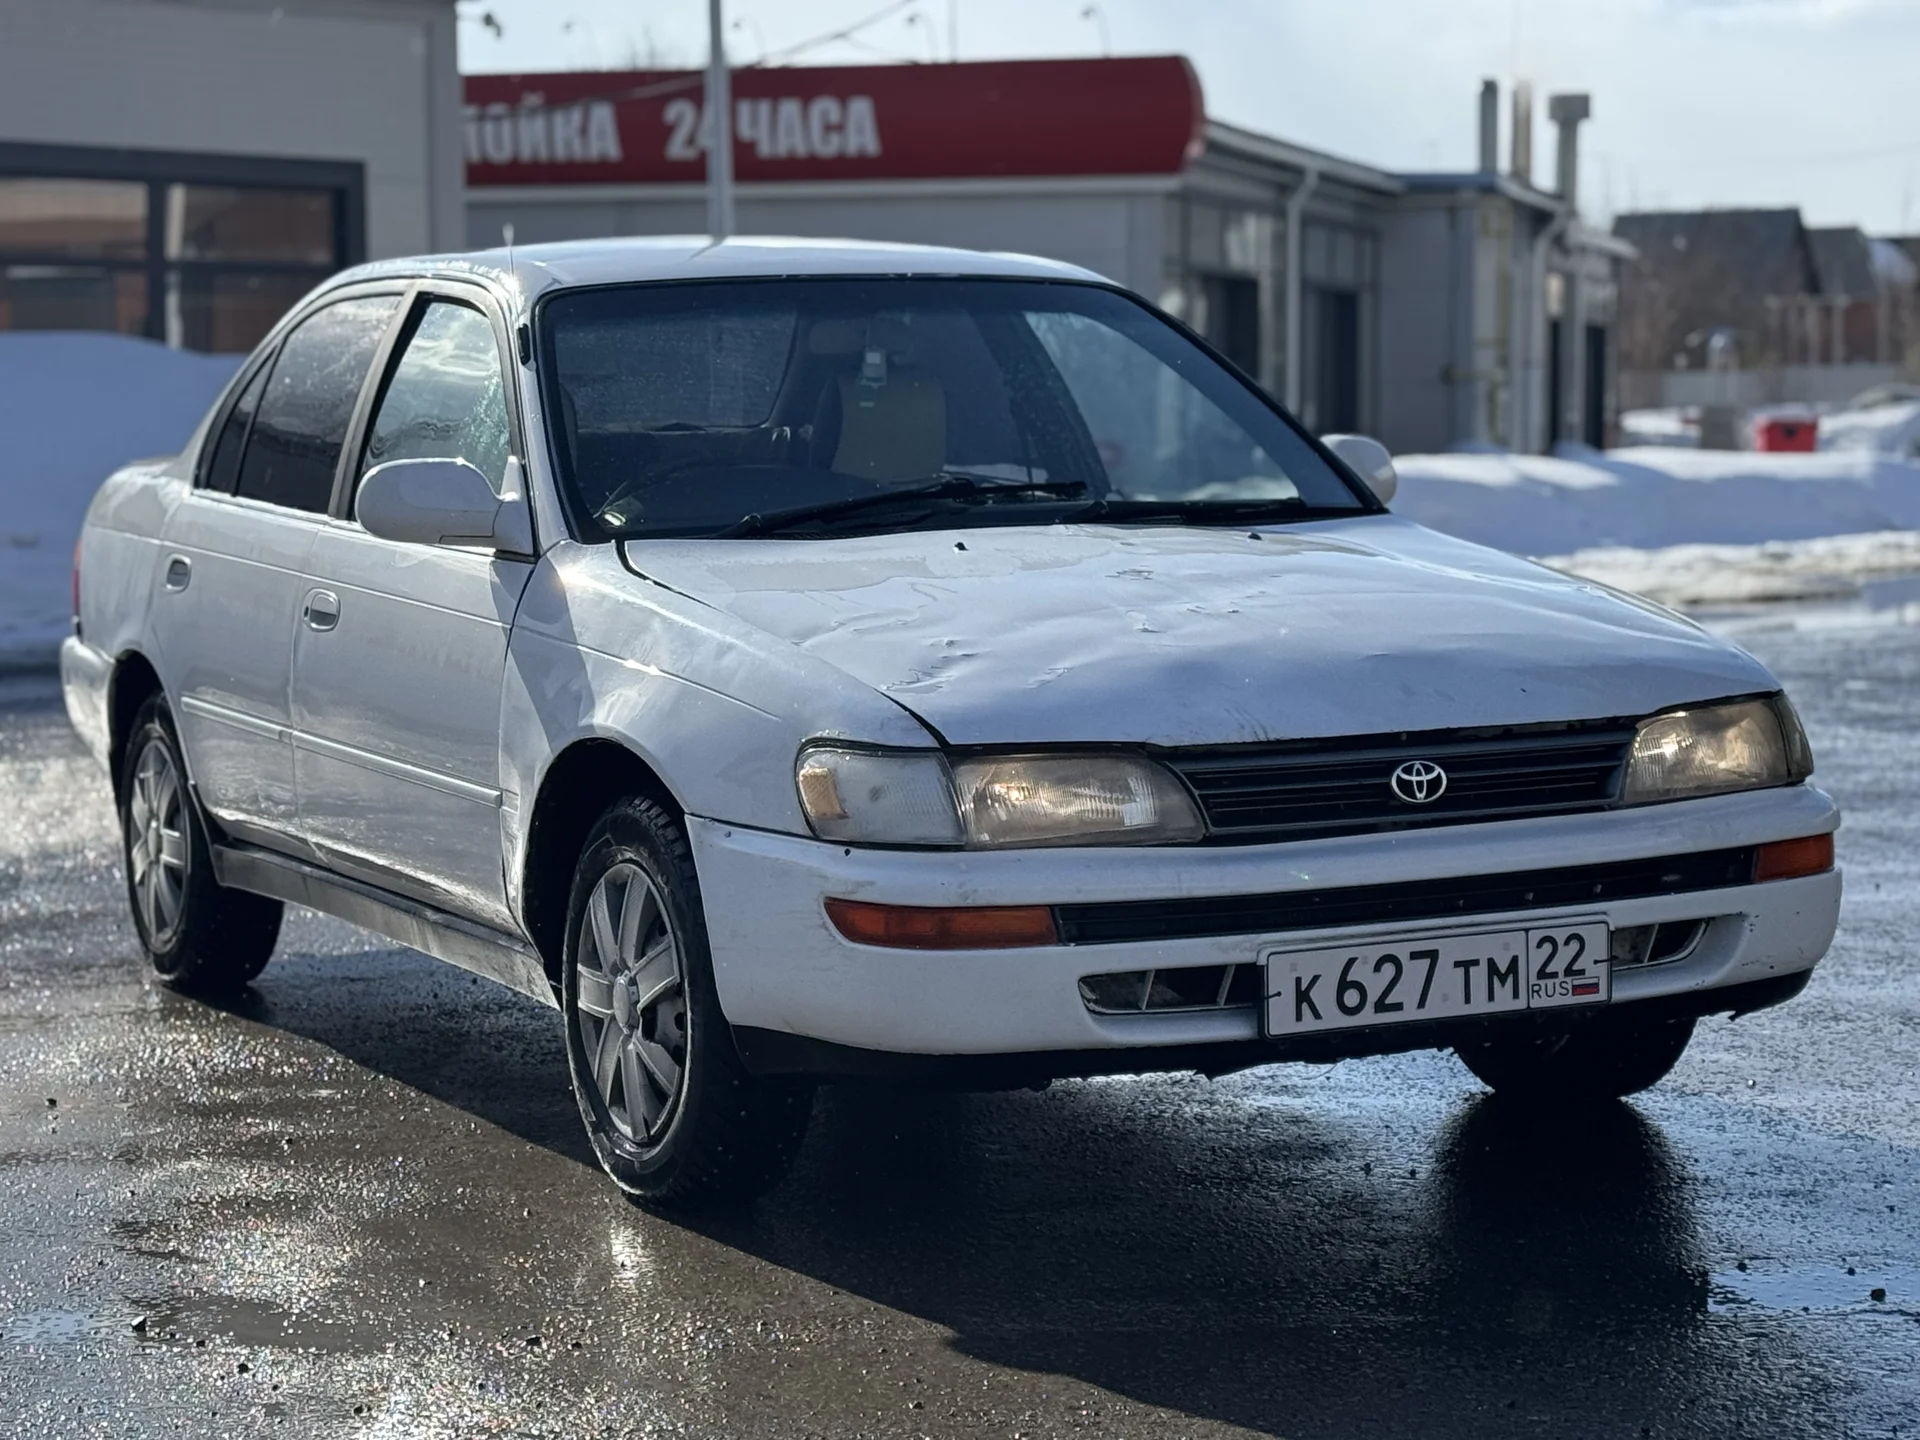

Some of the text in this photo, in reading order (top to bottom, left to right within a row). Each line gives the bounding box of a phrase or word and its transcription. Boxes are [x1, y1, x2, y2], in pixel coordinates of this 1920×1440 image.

[735, 96, 881, 159] ЧАСА
[1536, 932, 1586, 981] 22
[1530, 980, 1570, 1000] RUS
